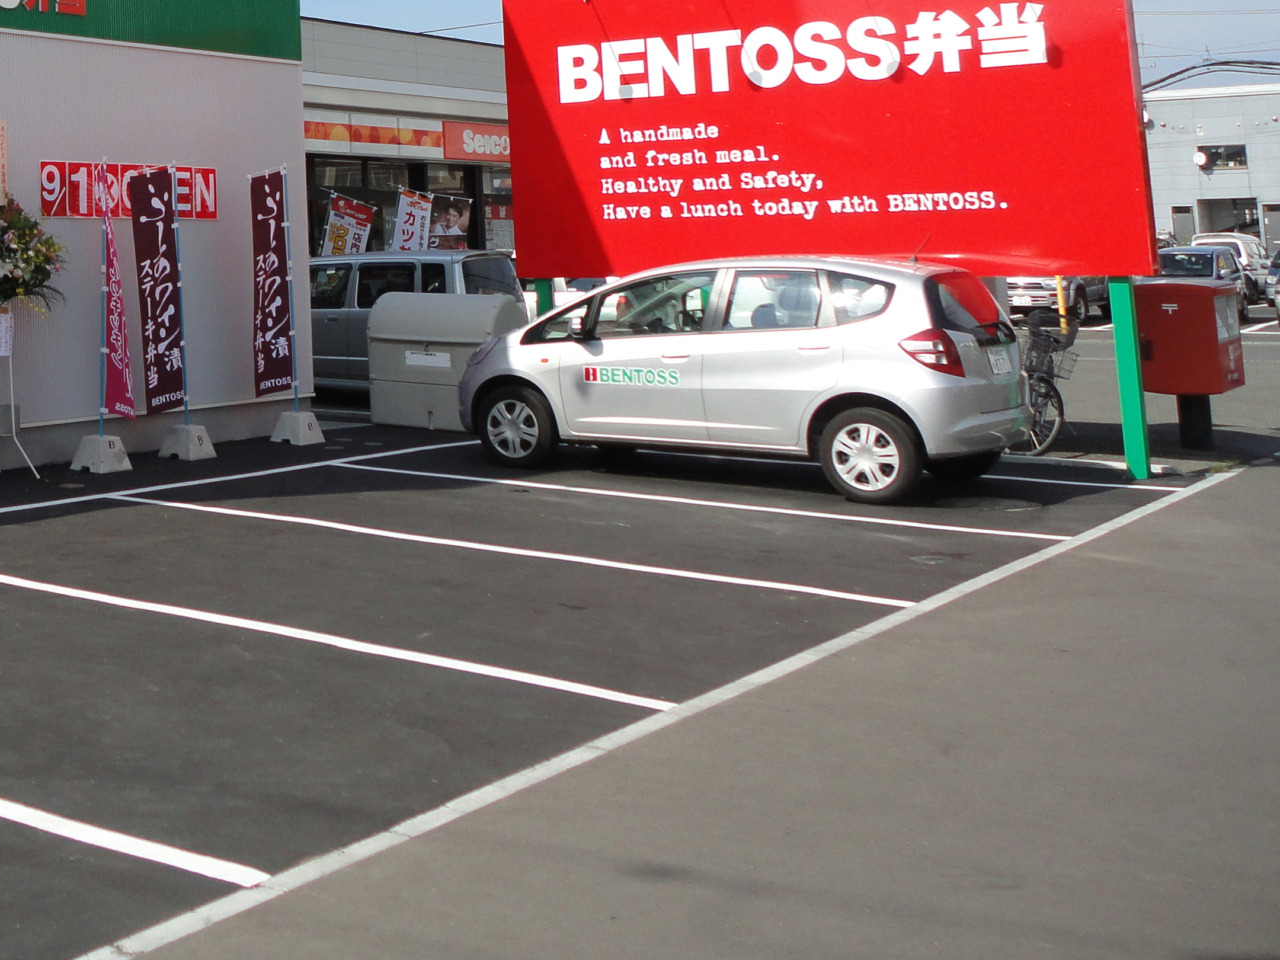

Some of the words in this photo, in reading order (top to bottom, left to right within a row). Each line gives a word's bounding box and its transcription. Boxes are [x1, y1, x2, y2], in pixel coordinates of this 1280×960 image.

[598, 128, 611, 144] A
[620, 123, 719, 143] handmade
[599, 151, 637, 169] and
[645, 148, 707, 167] fresh
[715, 146, 780, 164] meal.
[121, 169, 215, 213] OEN
[601, 176, 683, 197] Healthy
[692, 173, 732, 191] and
[740, 170, 823, 193] Safety,
[603, 203, 651, 220] Have
[660, 205, 673, 218] a
[680, 200, 743, 218] lunch
[752, 198, 818, 220] today
[827, 195, 879, 213] with
[886, 191, 1008, 212] BENTOSS.
[140, 258, 159, 389] ステーキ弁当
[255, 253, 265, 373] ステーキ弁当
[599, 367, 680, 385] BENTOSS
[152, 389, 185, 407] BENTOSS
